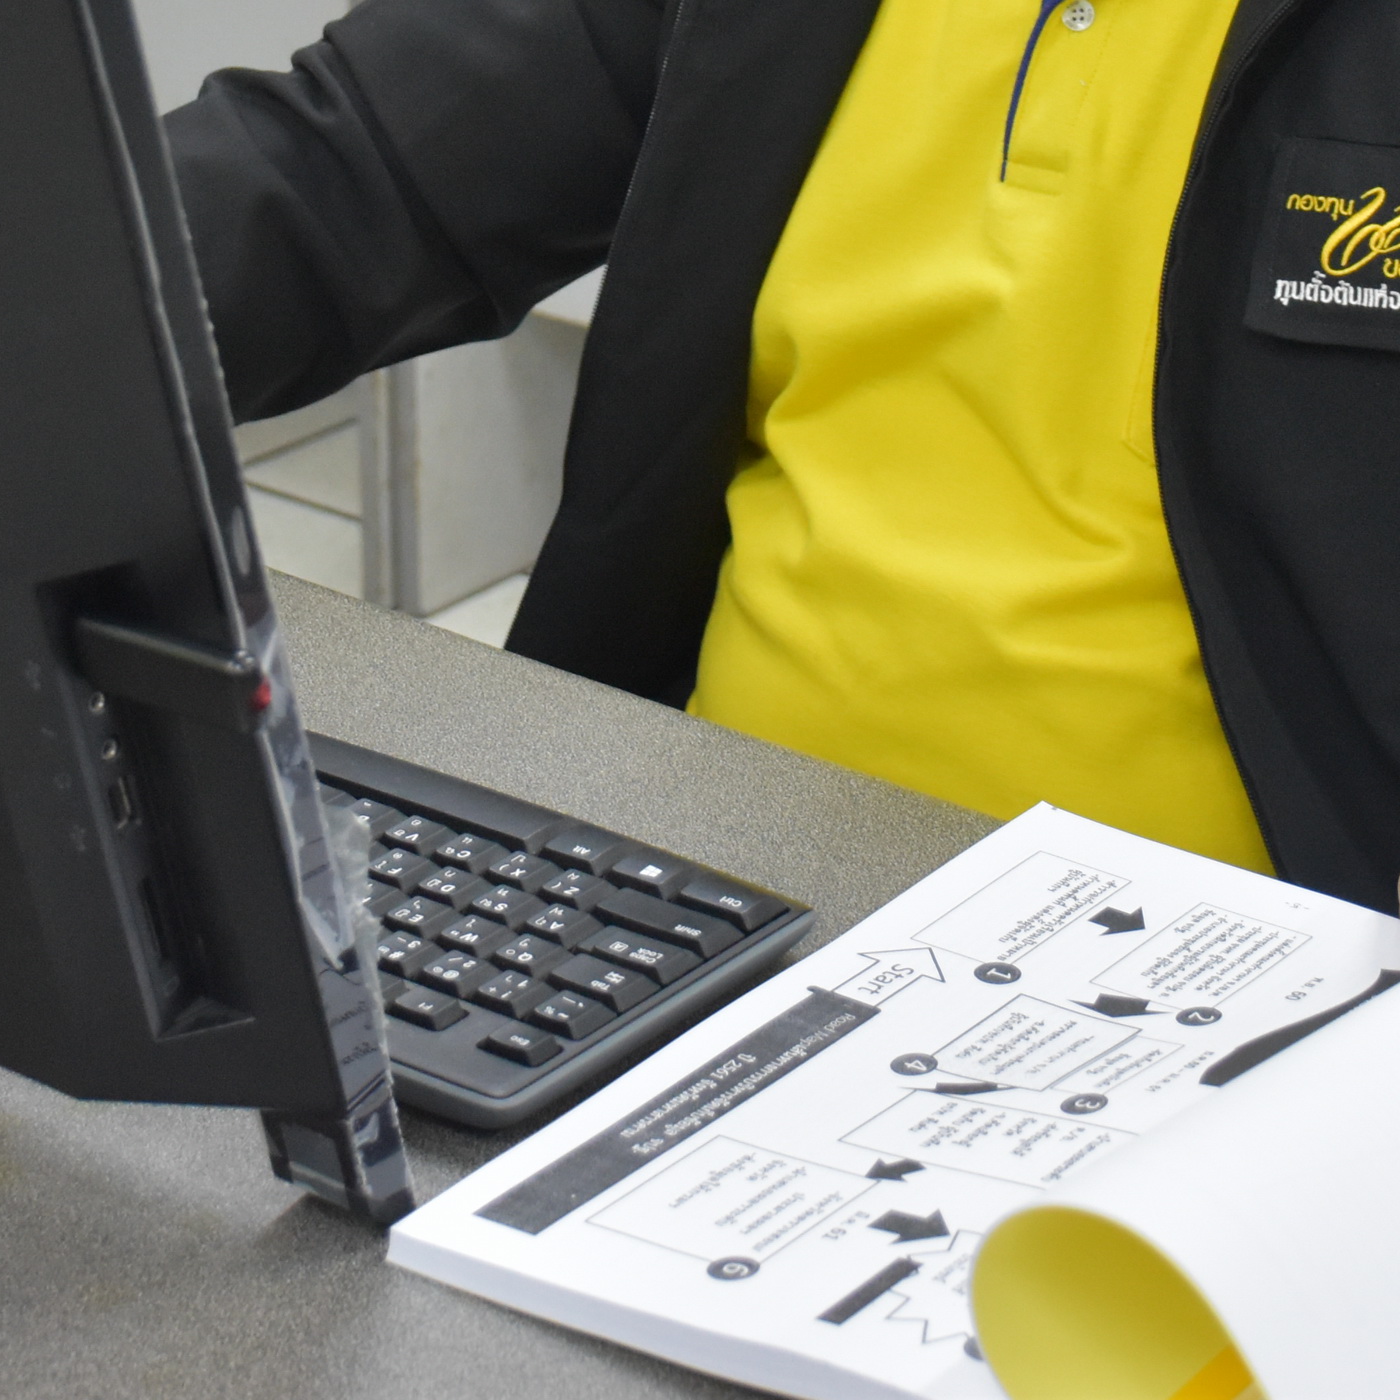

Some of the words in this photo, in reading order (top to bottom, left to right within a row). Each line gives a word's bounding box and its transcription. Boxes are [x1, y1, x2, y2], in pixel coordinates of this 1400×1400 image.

[1286, 193, 1354, 221] กองทุน
[572, 845, 591, 855] Alt
[719, 895, 742, 907] Ctrl
[674, 924, 702, 936] Shift
[636, 947, 664, 959] Lock
[590, 979, 611, 991] Tab
[857, 963, 915, 995] Start
[822, 1012, 857, 1034] Road
[510, 1034, 531, 1046] Esc
[709, 1058, 743, 1080] 2561
